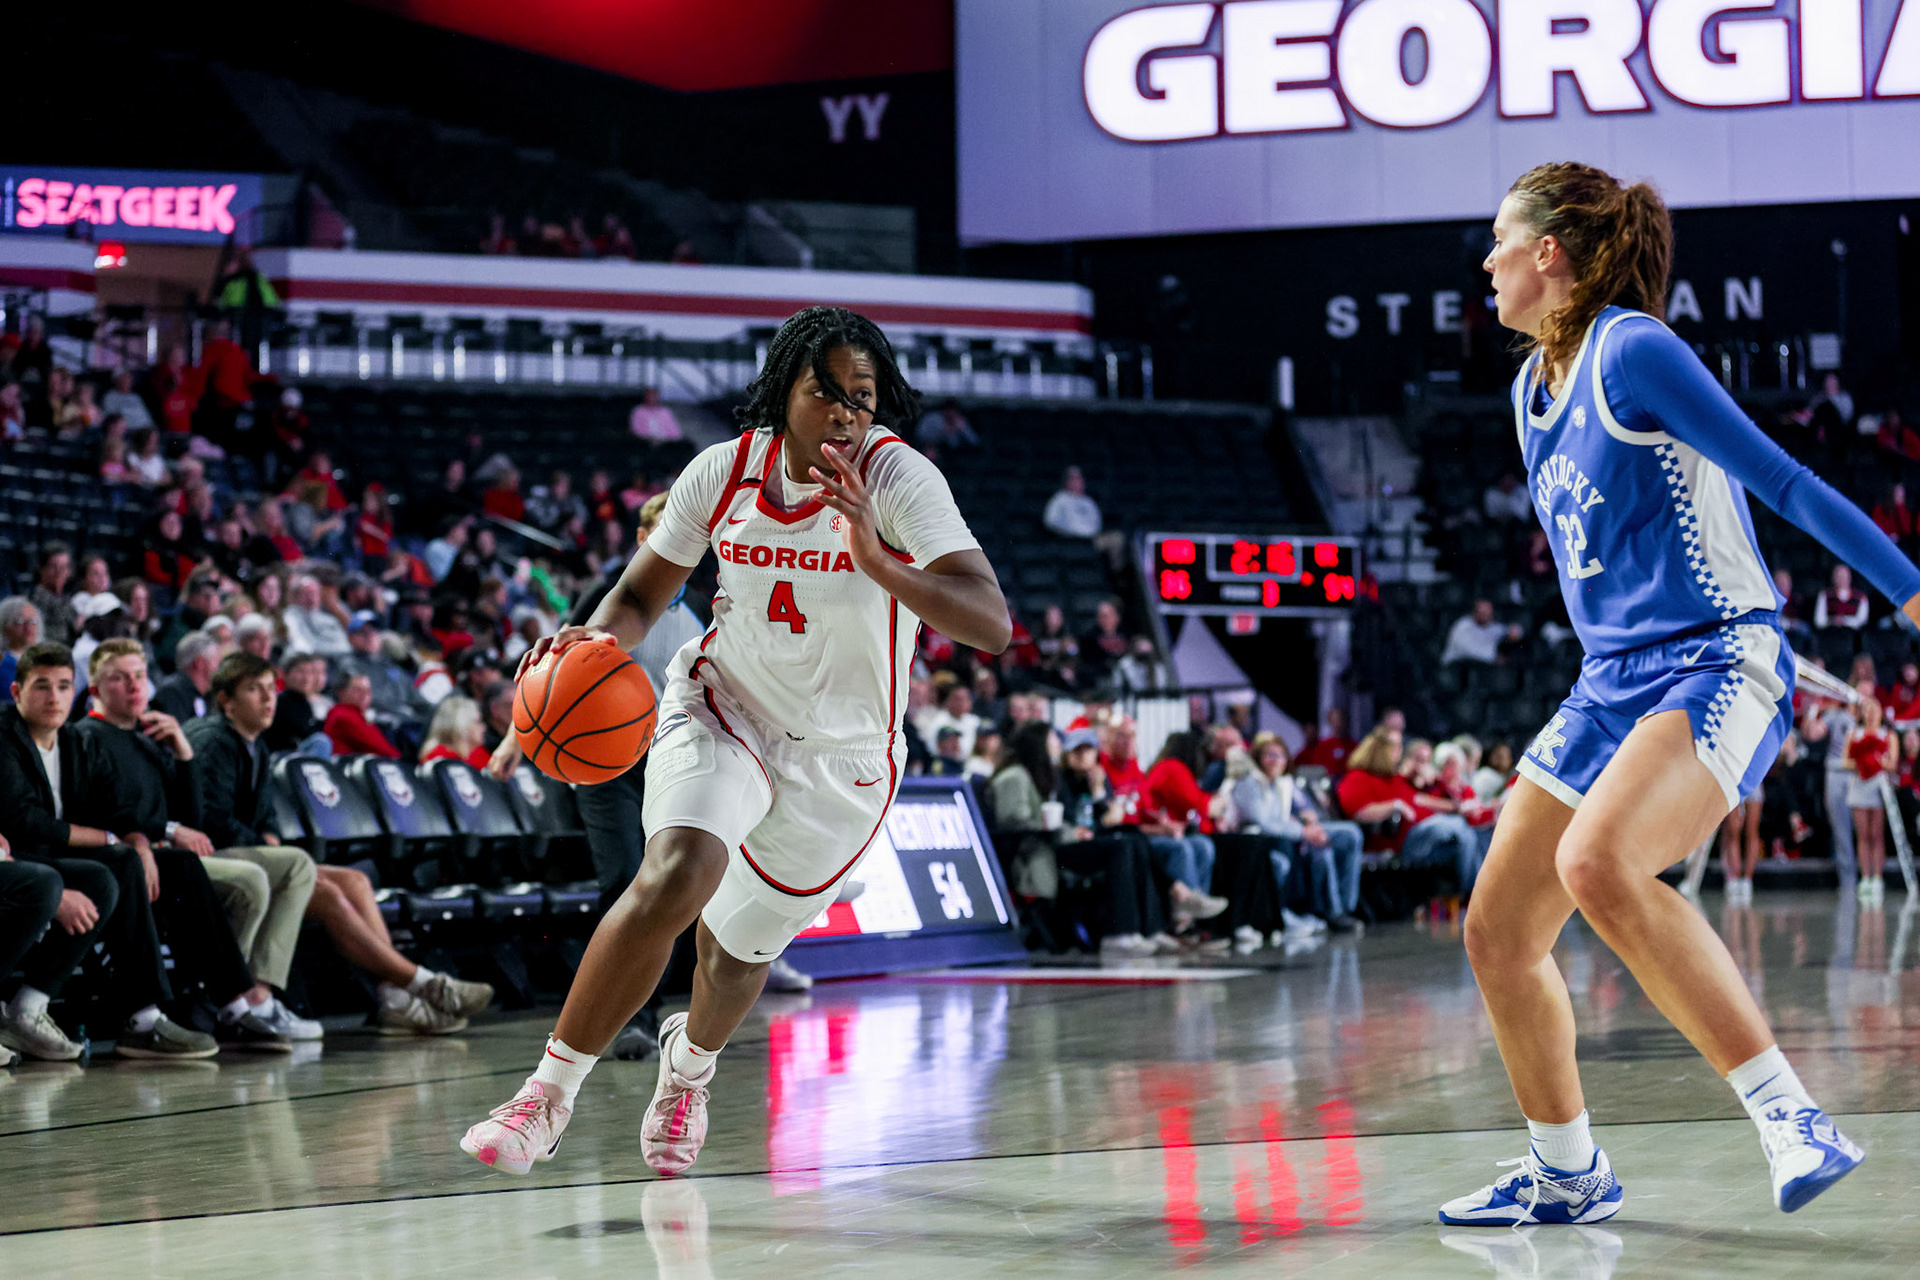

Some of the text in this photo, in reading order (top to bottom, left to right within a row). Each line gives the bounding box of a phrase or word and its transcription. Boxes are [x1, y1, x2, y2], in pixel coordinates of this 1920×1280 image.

[821, 93, 889, 142] YY
[16, 177, 237, 234] SEATGEEK
[1537, 454, 1605, 517] KENTUCKY
[719, 540, 856, 573] GEORGIA
[1555, 513, 1604, 580] 32
[767, 580, 808, 634] 4
